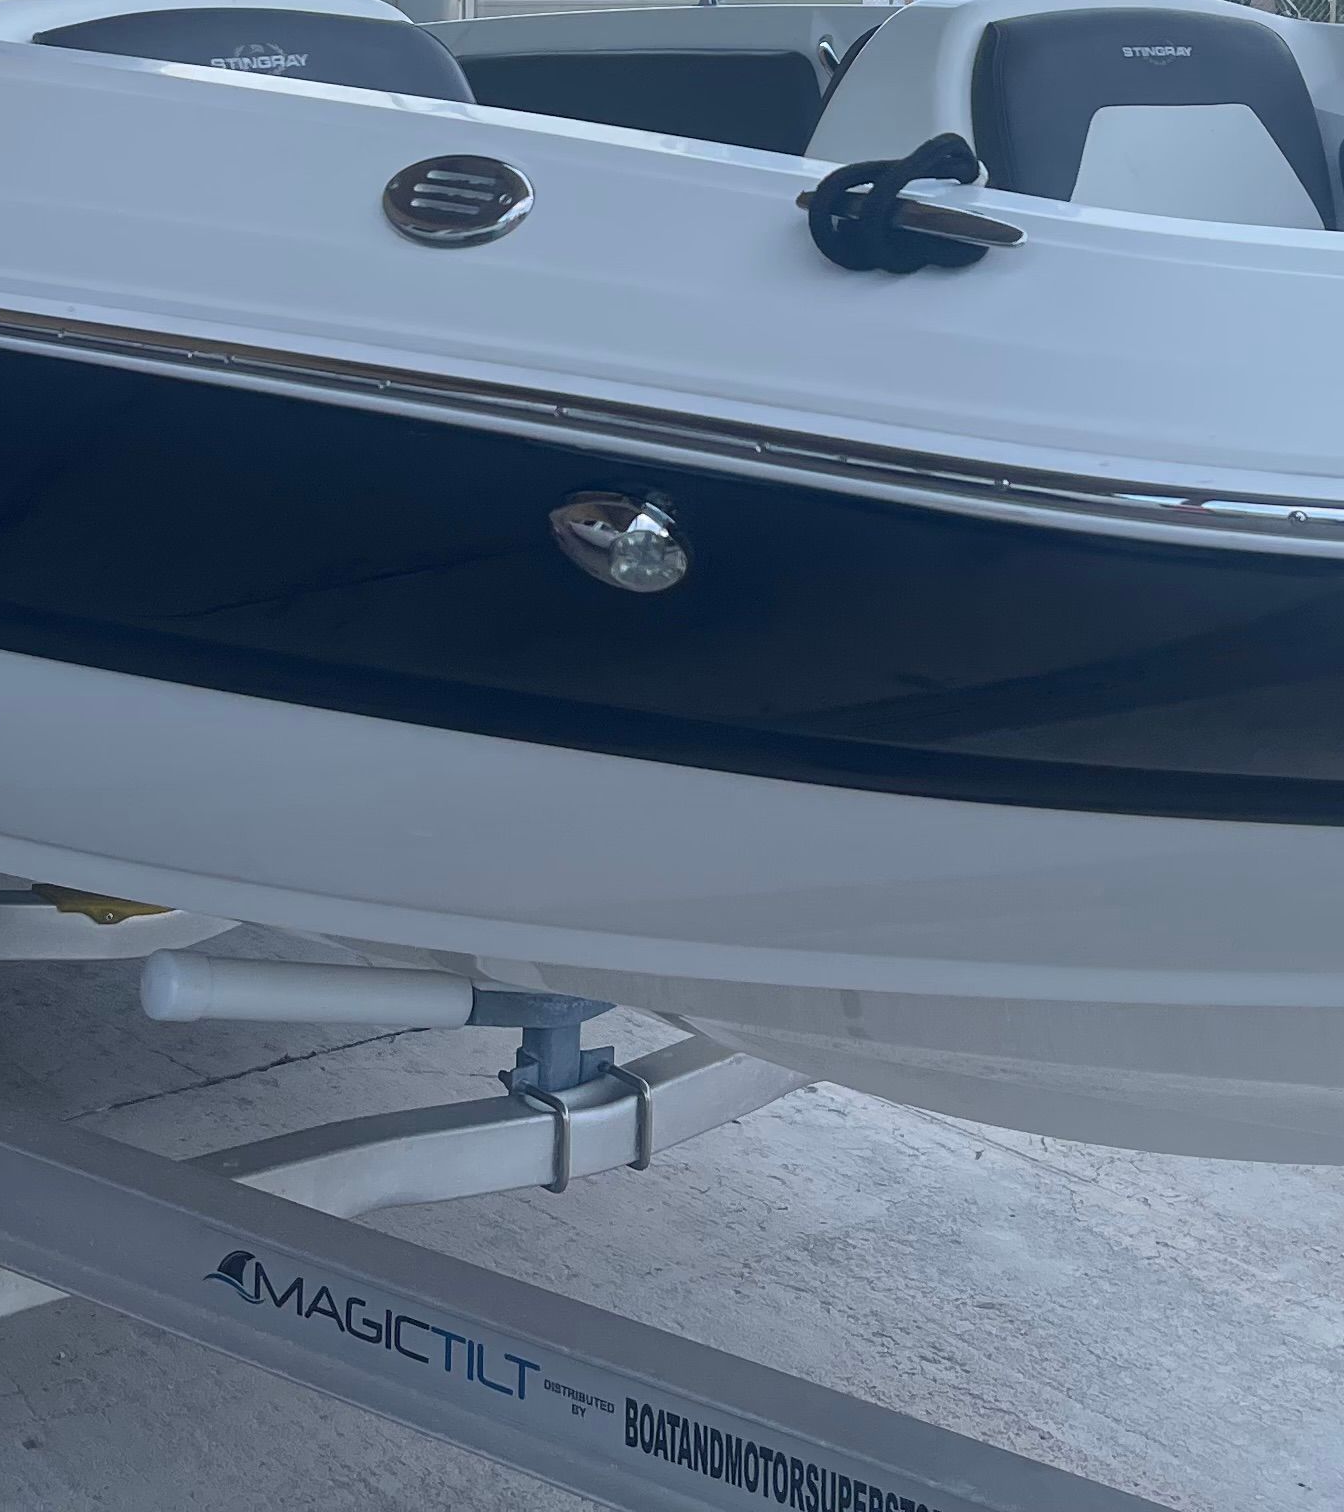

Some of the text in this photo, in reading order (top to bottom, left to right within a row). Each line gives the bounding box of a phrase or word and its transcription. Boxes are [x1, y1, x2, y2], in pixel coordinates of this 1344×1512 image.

[1121, 46, 1193, 57] STINGRAY
[210, 53, 309, 70] STINGRAY
[255, 1261, 541, 1401] MAGICTILT
[543, 1378, 615, 1414] DISTRIBUTED
[571, 1403, 587, 1418] BY
